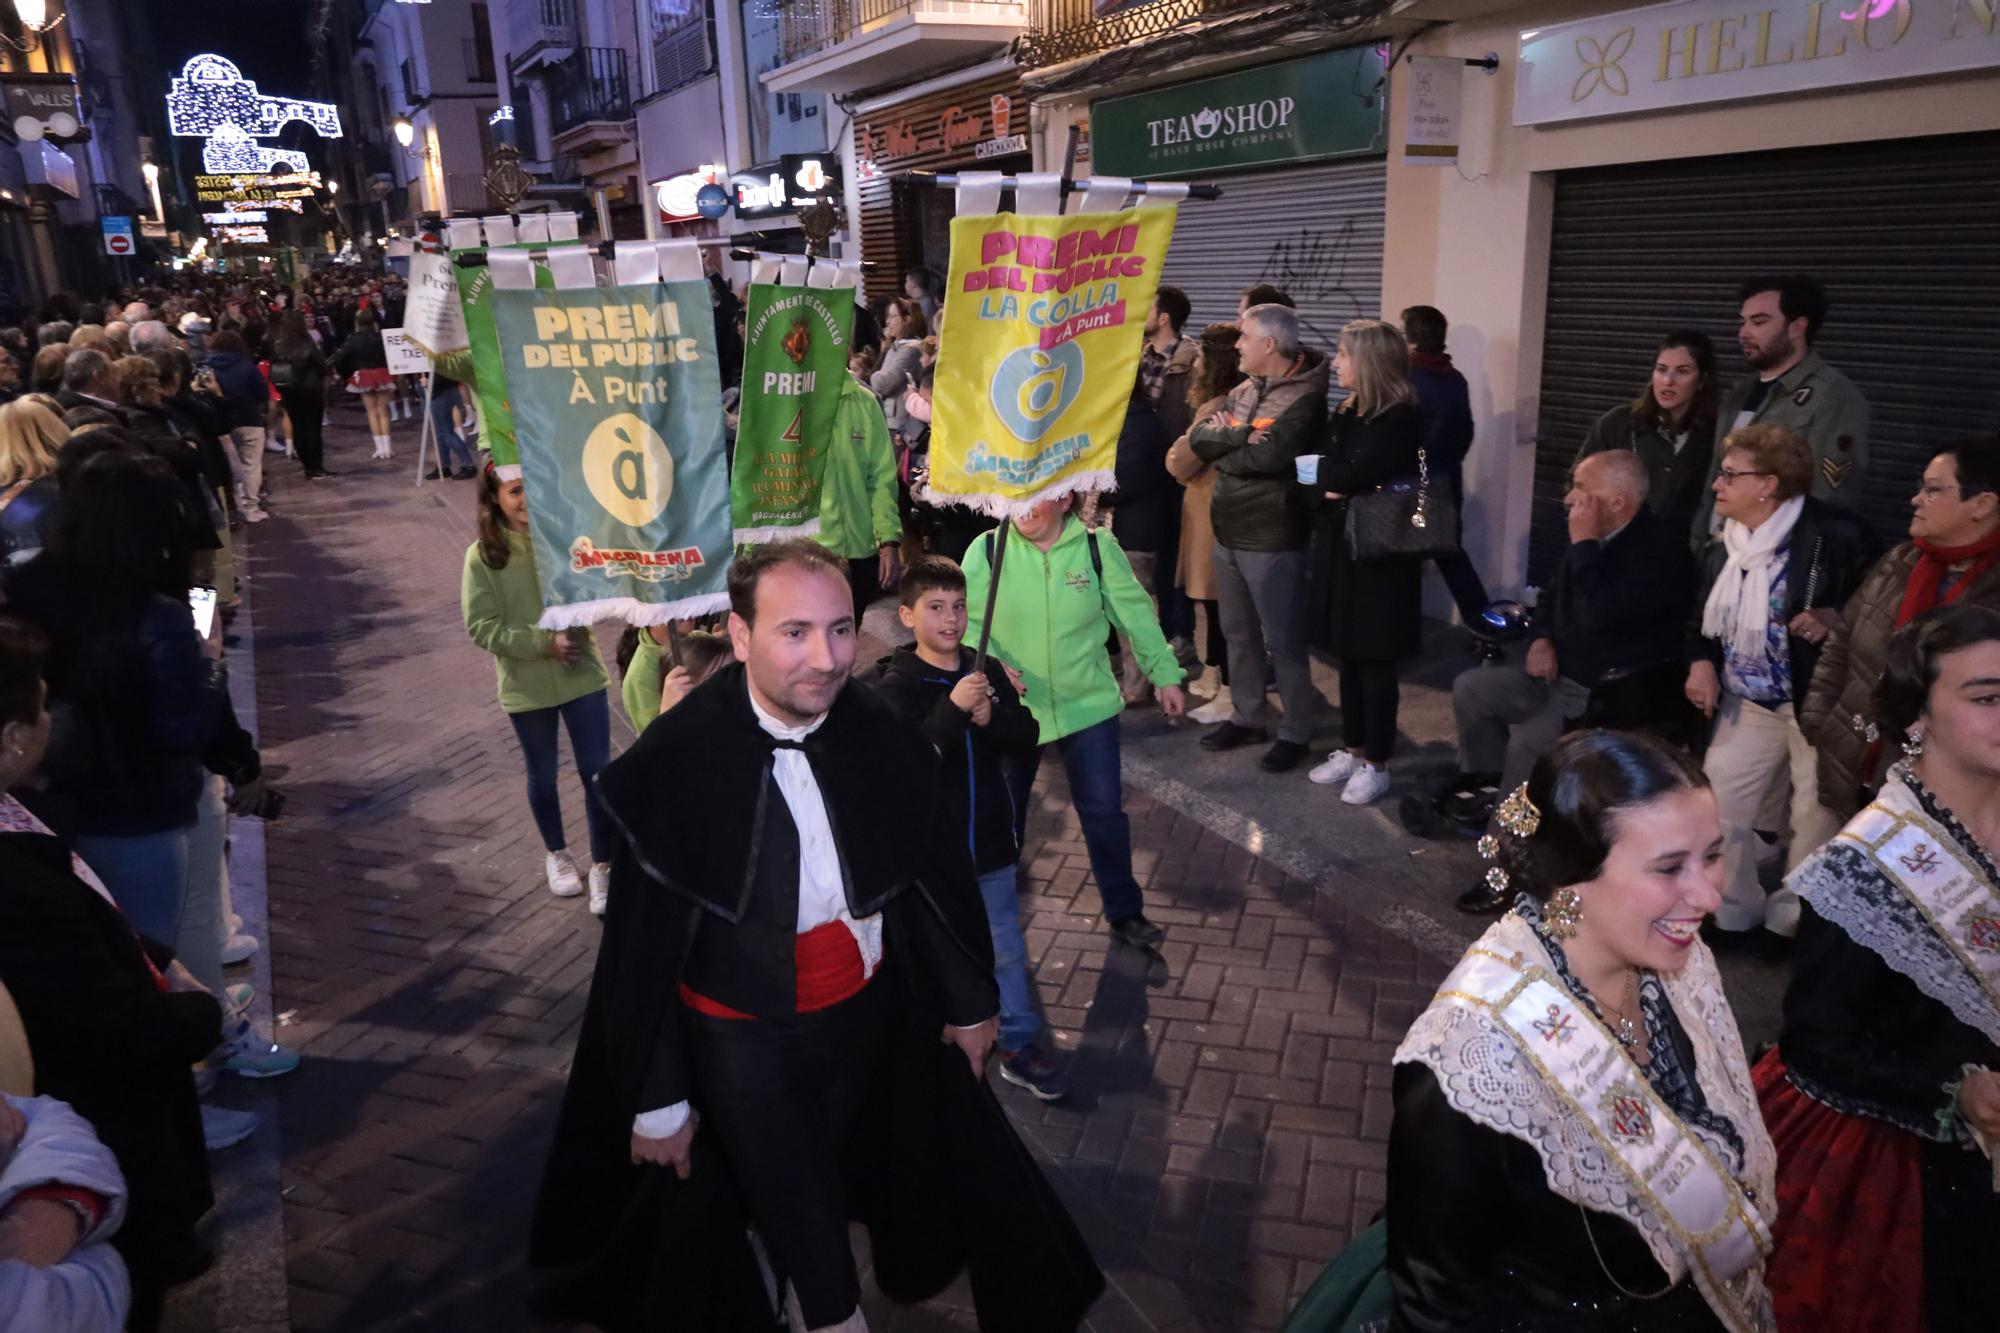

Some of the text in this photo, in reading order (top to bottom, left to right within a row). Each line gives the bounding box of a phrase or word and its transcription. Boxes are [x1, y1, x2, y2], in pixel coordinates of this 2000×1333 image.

[1653, 0, 1913, 82] HELLO
[28, 93, 73, 108] VALLS
[1147, 96, 1295, 147] TEA SHOP
[982, 224, 1140, 270] PREMI
[963, 266, 1027, 293] DEL
[533, 301, 681, 342] PREMI
[751, 295, 803, 346] AJUNTAMENT
[979, 282, 1118, 327] LA COLLA
[522, 338, 700, 369] DEL PÚBLIC
[569, 369, 668, 405] À Punt
[763, 371, 816, 395] PREMI
[780, 405, 805, 447] 4
